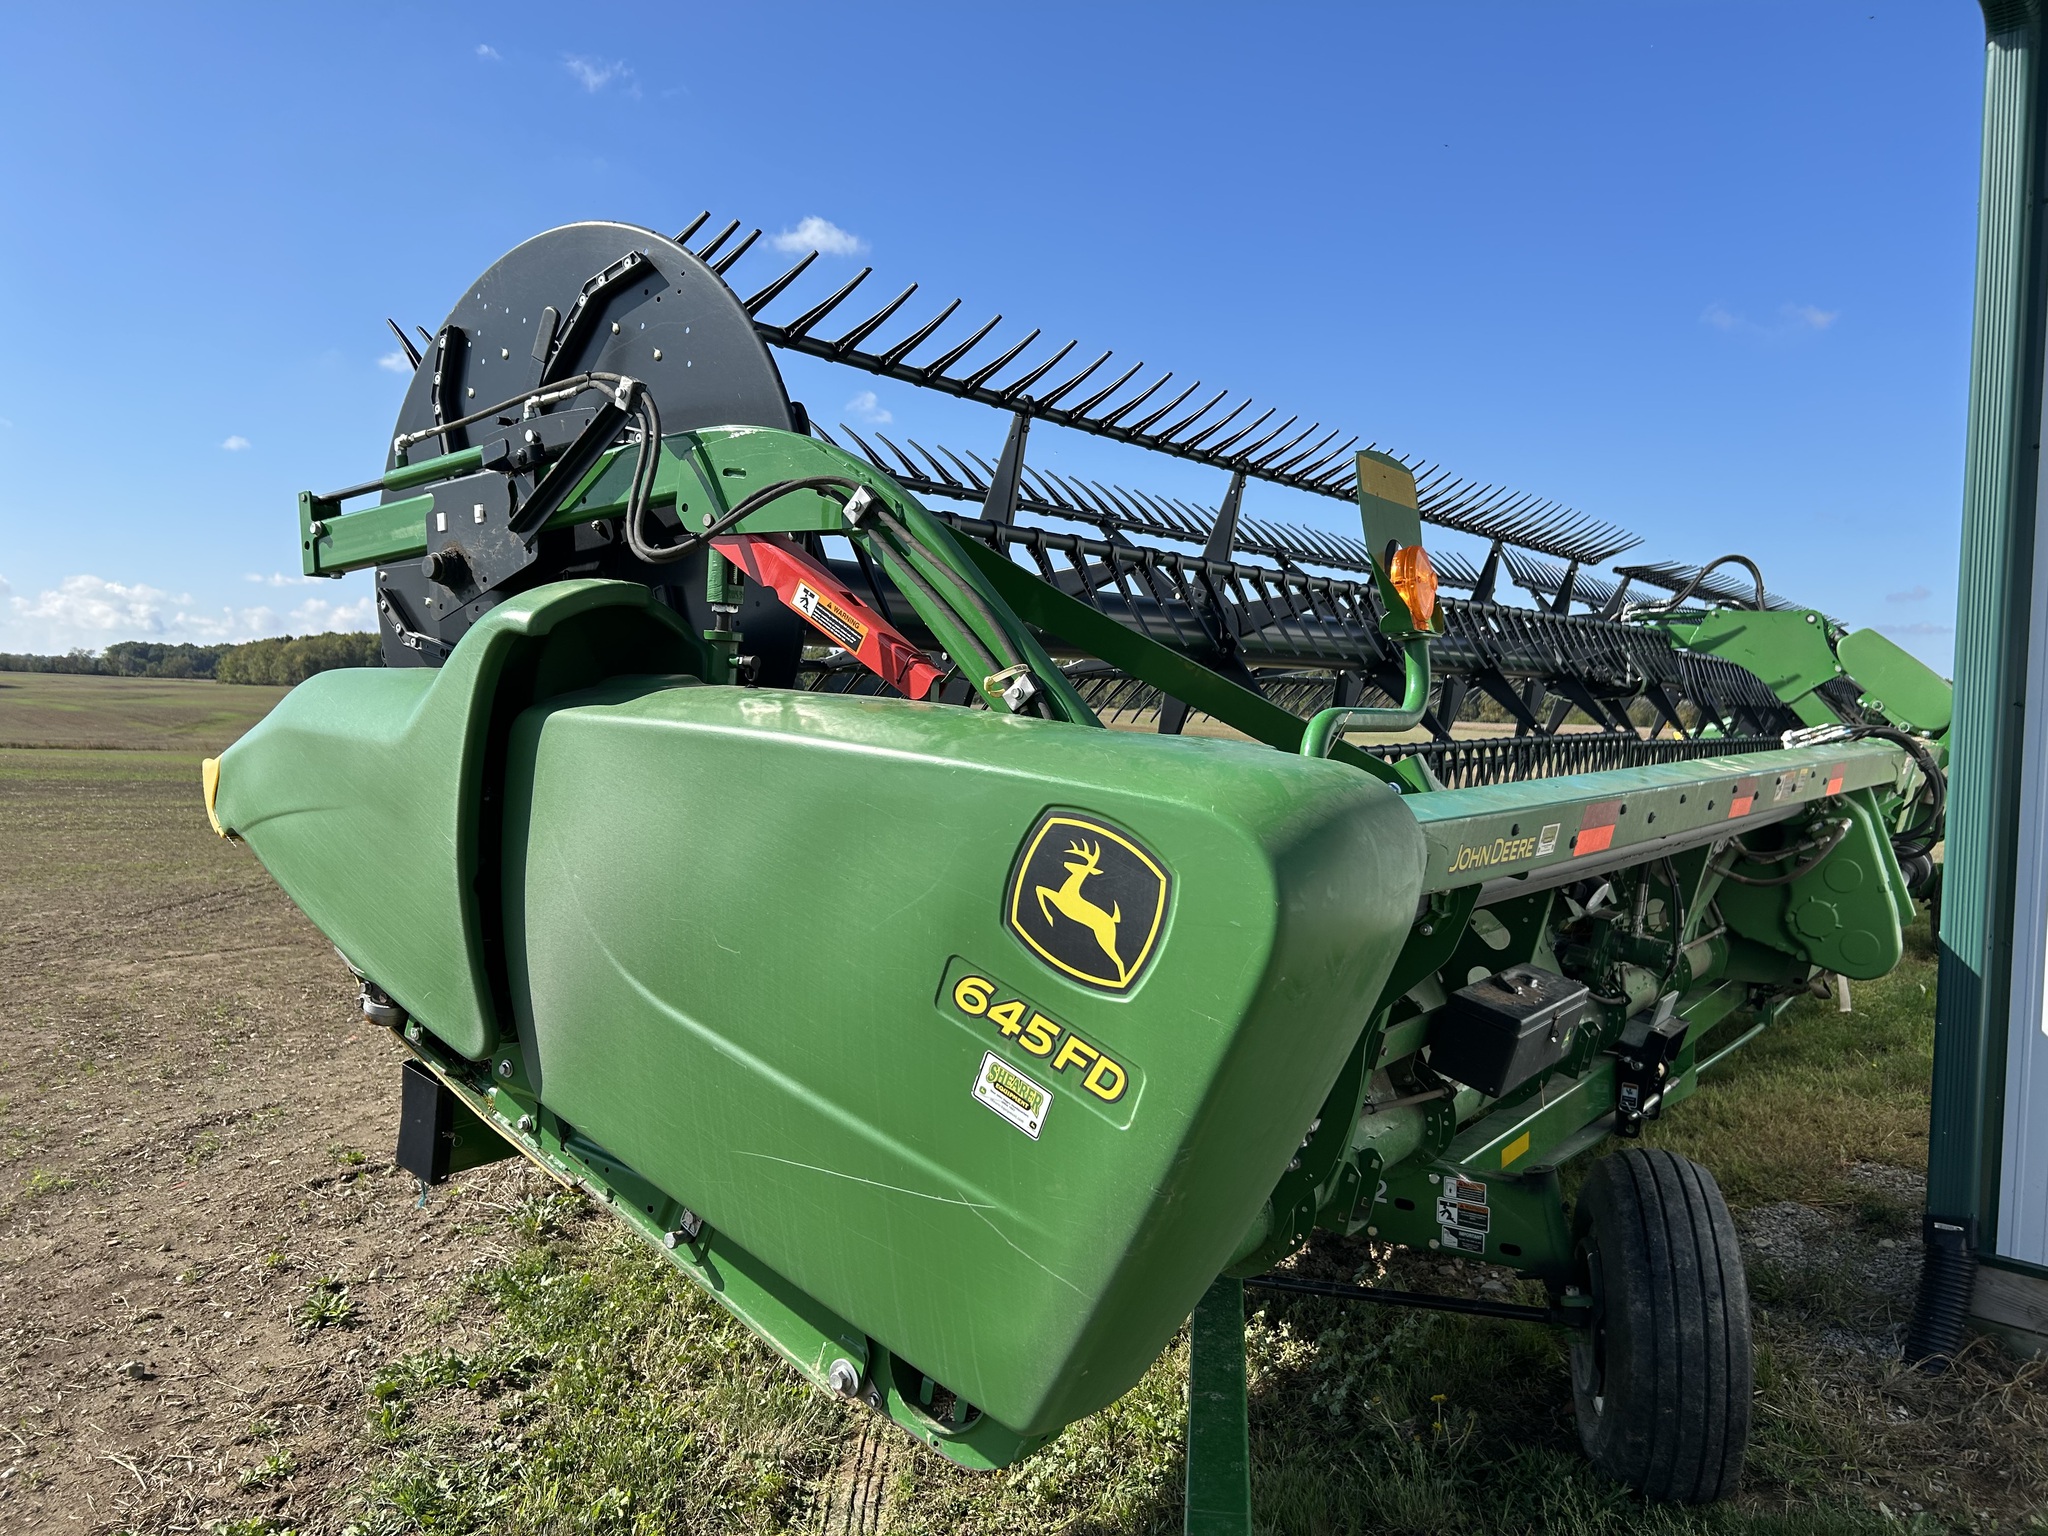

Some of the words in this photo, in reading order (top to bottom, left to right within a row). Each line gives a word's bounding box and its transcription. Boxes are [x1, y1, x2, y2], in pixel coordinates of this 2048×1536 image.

[833, 605, 861, 630] WARNING
[1448, 843, 1490, 873] JOHN
[1490, 836, 1537, 864] DEERE
[954, 975, 1129, 1103] 645FD
[986, 1062, 1044, 1119] SHEARER
[995, 1083, 1030, 1110] EQUIPMENT
